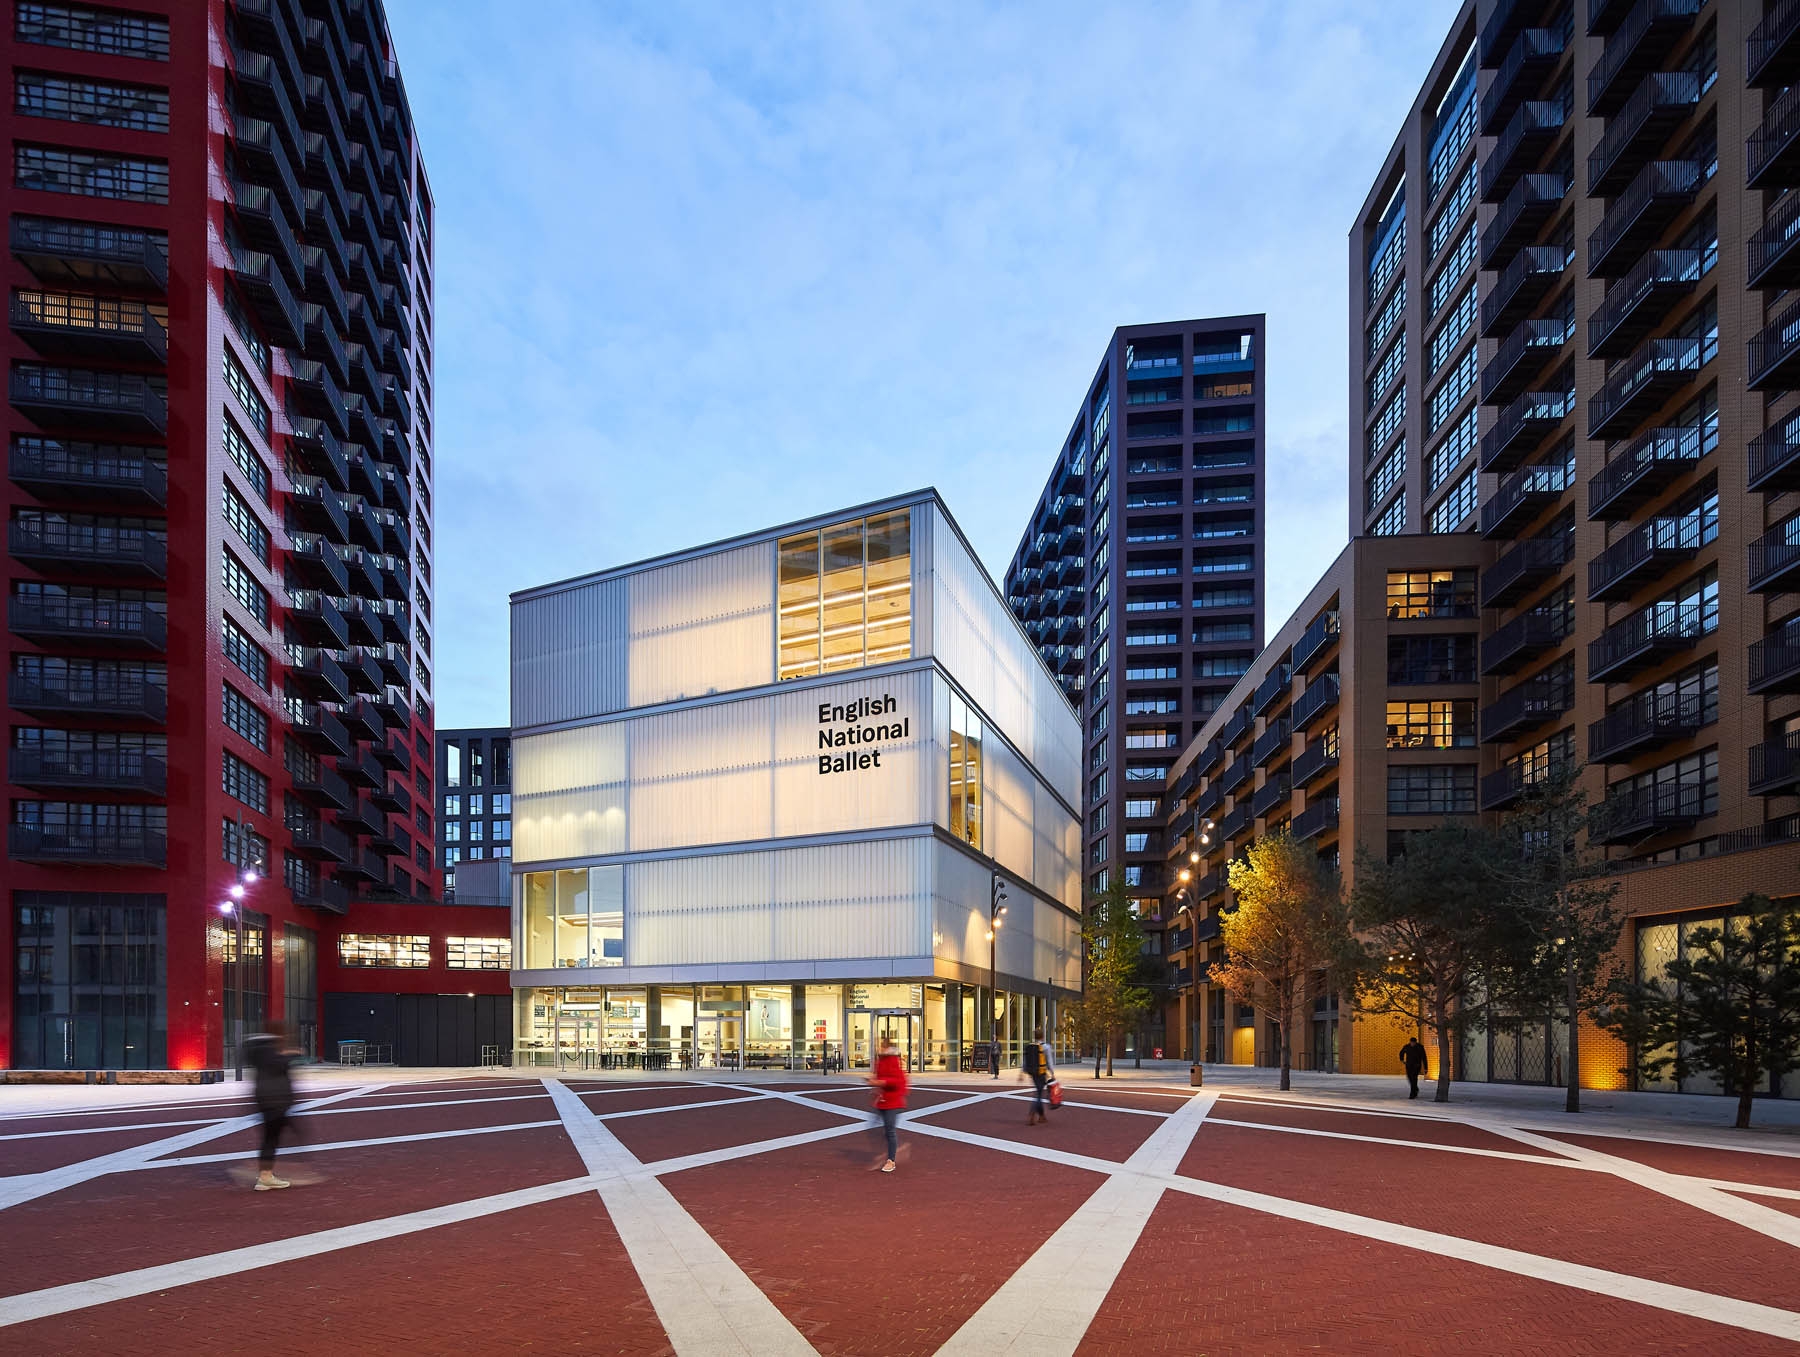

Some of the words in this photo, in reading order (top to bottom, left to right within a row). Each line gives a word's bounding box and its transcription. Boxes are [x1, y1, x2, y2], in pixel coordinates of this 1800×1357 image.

[819, 694, 896, 723] English
[819, 717, 909, 749] National
[819, 750, 881, 775] Ballet
